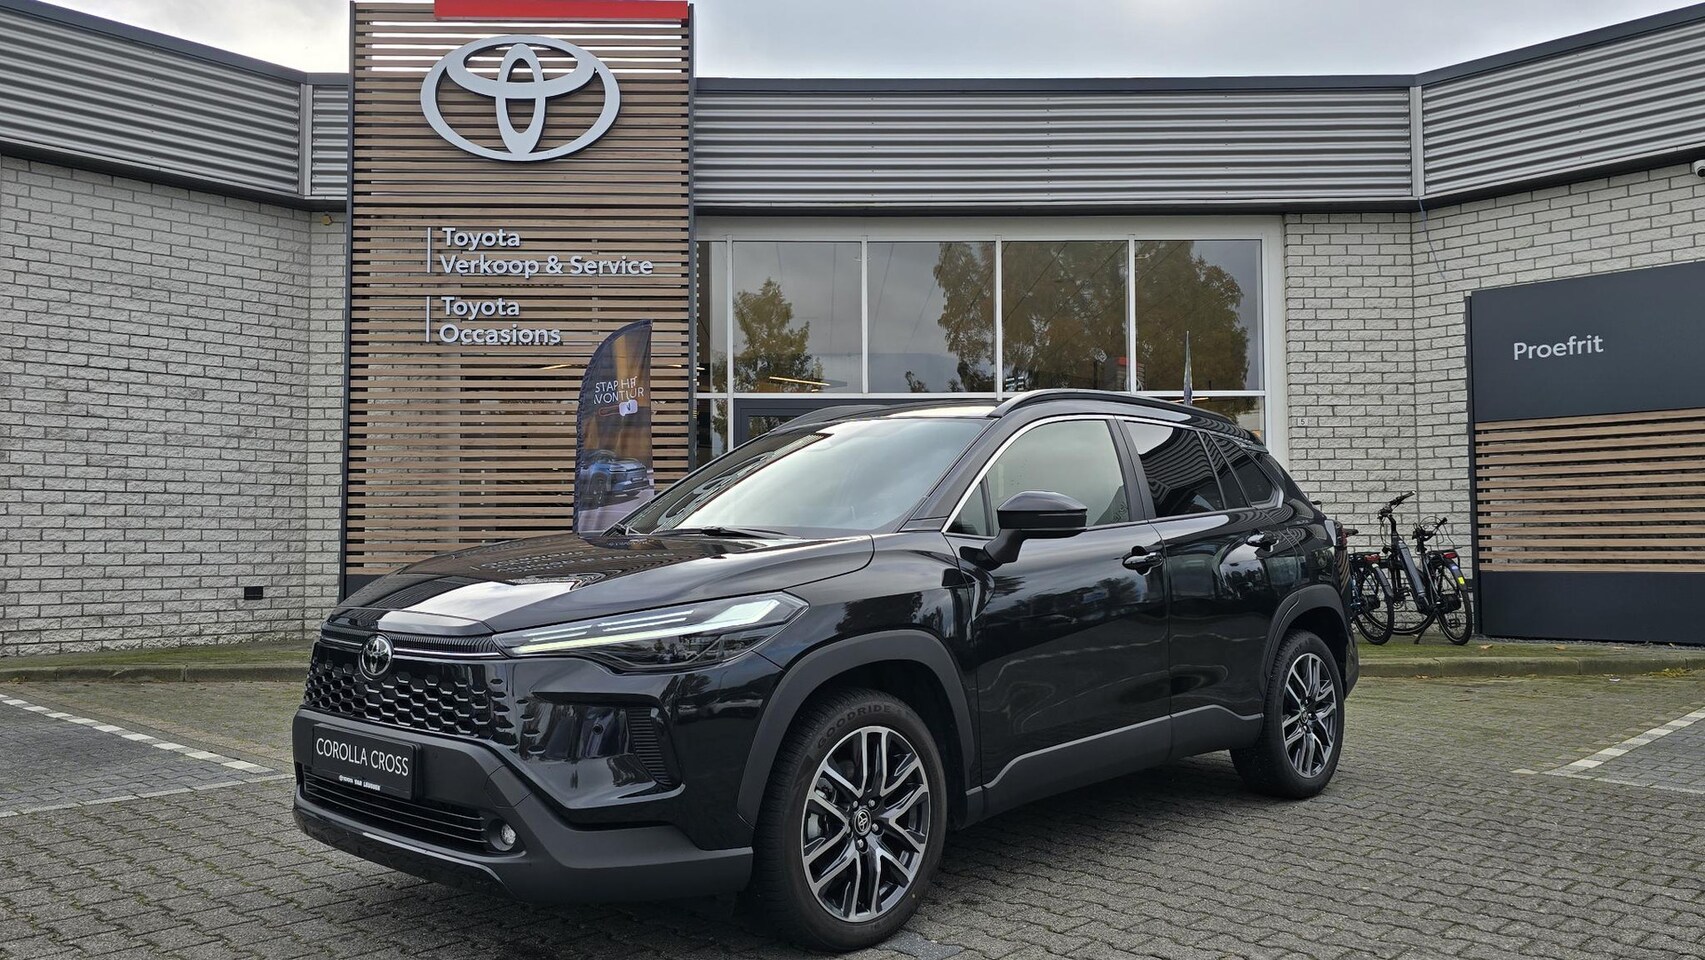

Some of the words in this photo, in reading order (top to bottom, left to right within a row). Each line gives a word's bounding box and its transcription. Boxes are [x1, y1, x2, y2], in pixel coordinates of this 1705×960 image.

[441, 227, 521, 251] Toyota
[439, 254, 540, 279] Verkoop
[545, 255, 564, 275] &
[569, 255, 654, 275] Service
[441, 296, 520, 320] Toyota
[439, 323, 561, 344] Occasions
[1513, 334, 1604, 361] Proefrit
[595, 380, 619, 393] STAP
[818, 704, 892, 748] GOODRIDE
[316, 737, 368, 767] COROLLA
[370, 750, 409, 777] CROSS
